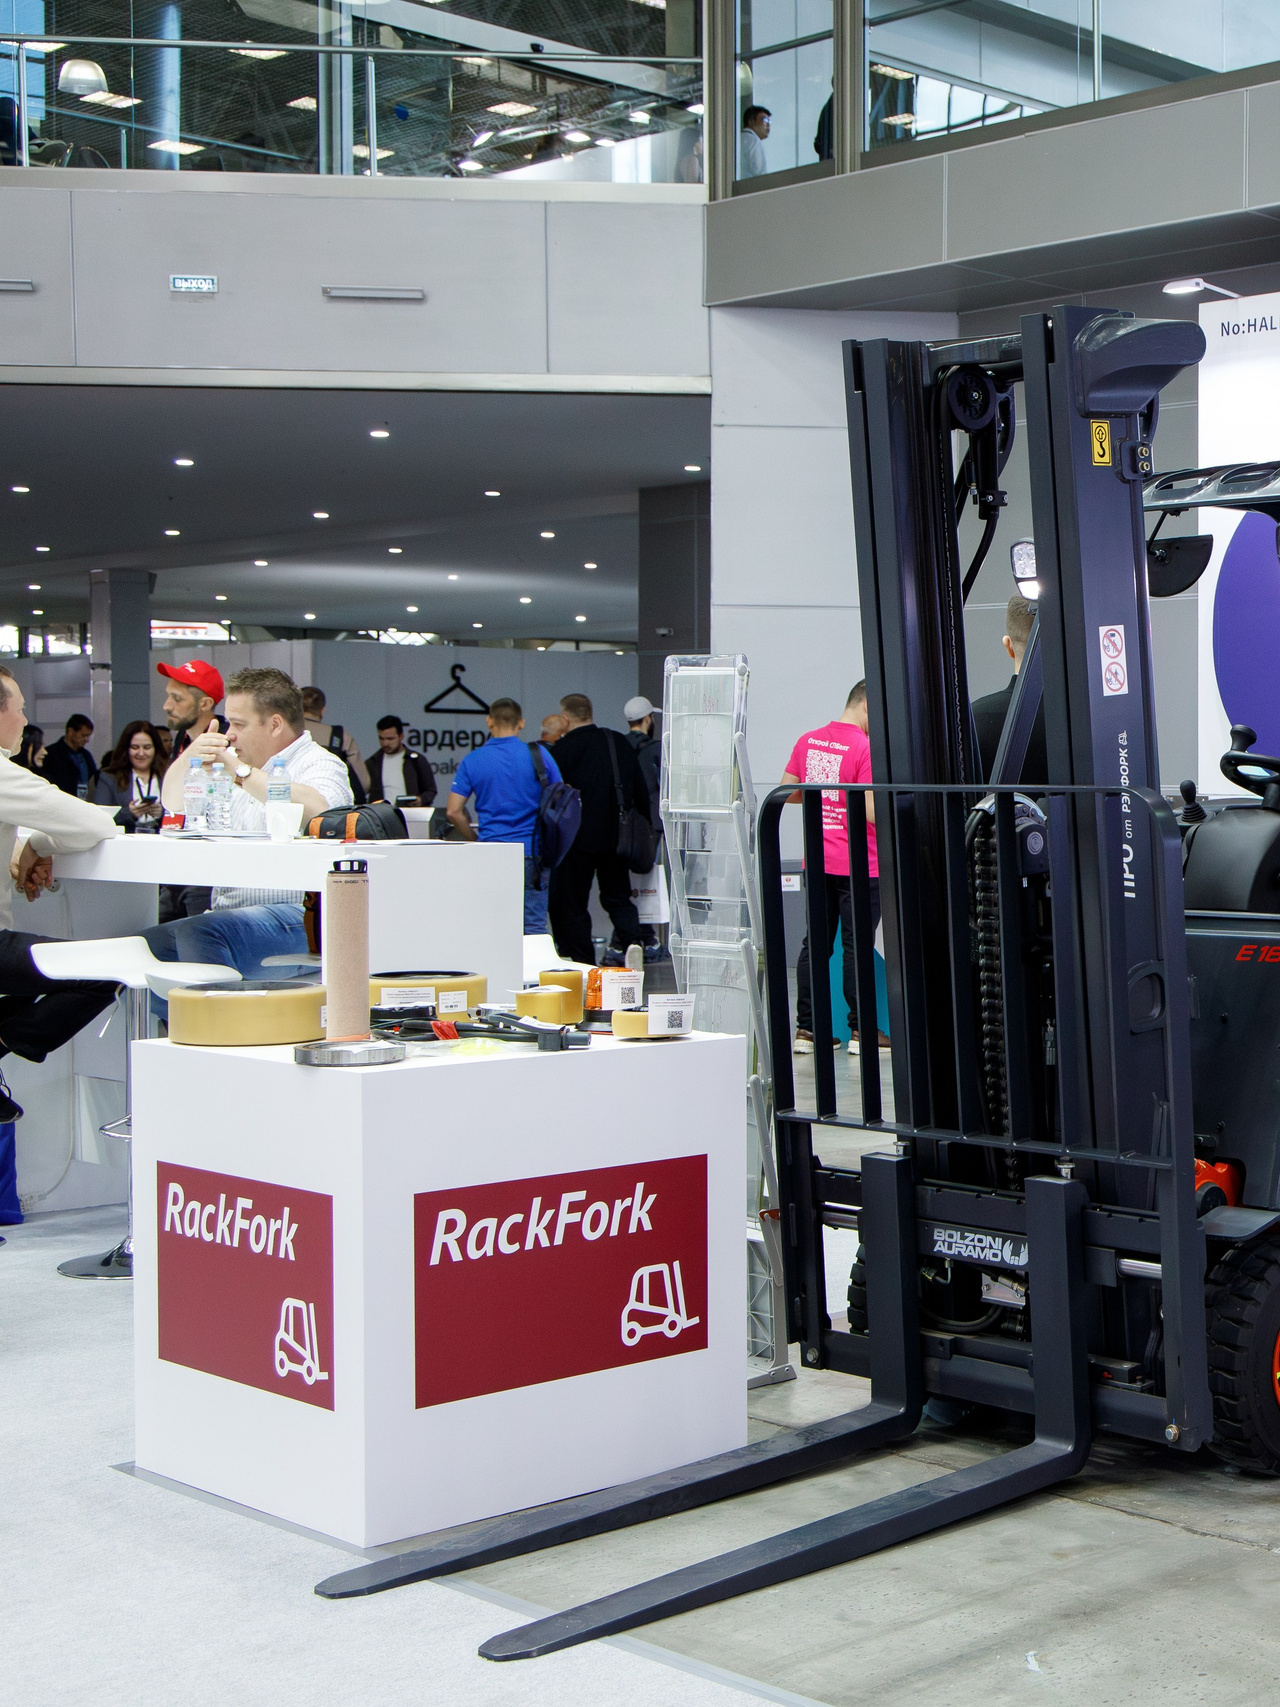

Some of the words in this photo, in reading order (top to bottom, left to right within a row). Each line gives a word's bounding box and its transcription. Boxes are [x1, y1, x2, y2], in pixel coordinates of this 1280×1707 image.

[174, 278, 213, 290] ВЫХОД
[402, 722, 492, 752] ардер
[164, 1182, 299, 1261] RackFork
[429, 1181, 658, 1266] RackFork
[933, 1228, 1003, 1250] BOLZONI
[933, 1241, 1002, 1262] AURAMO
